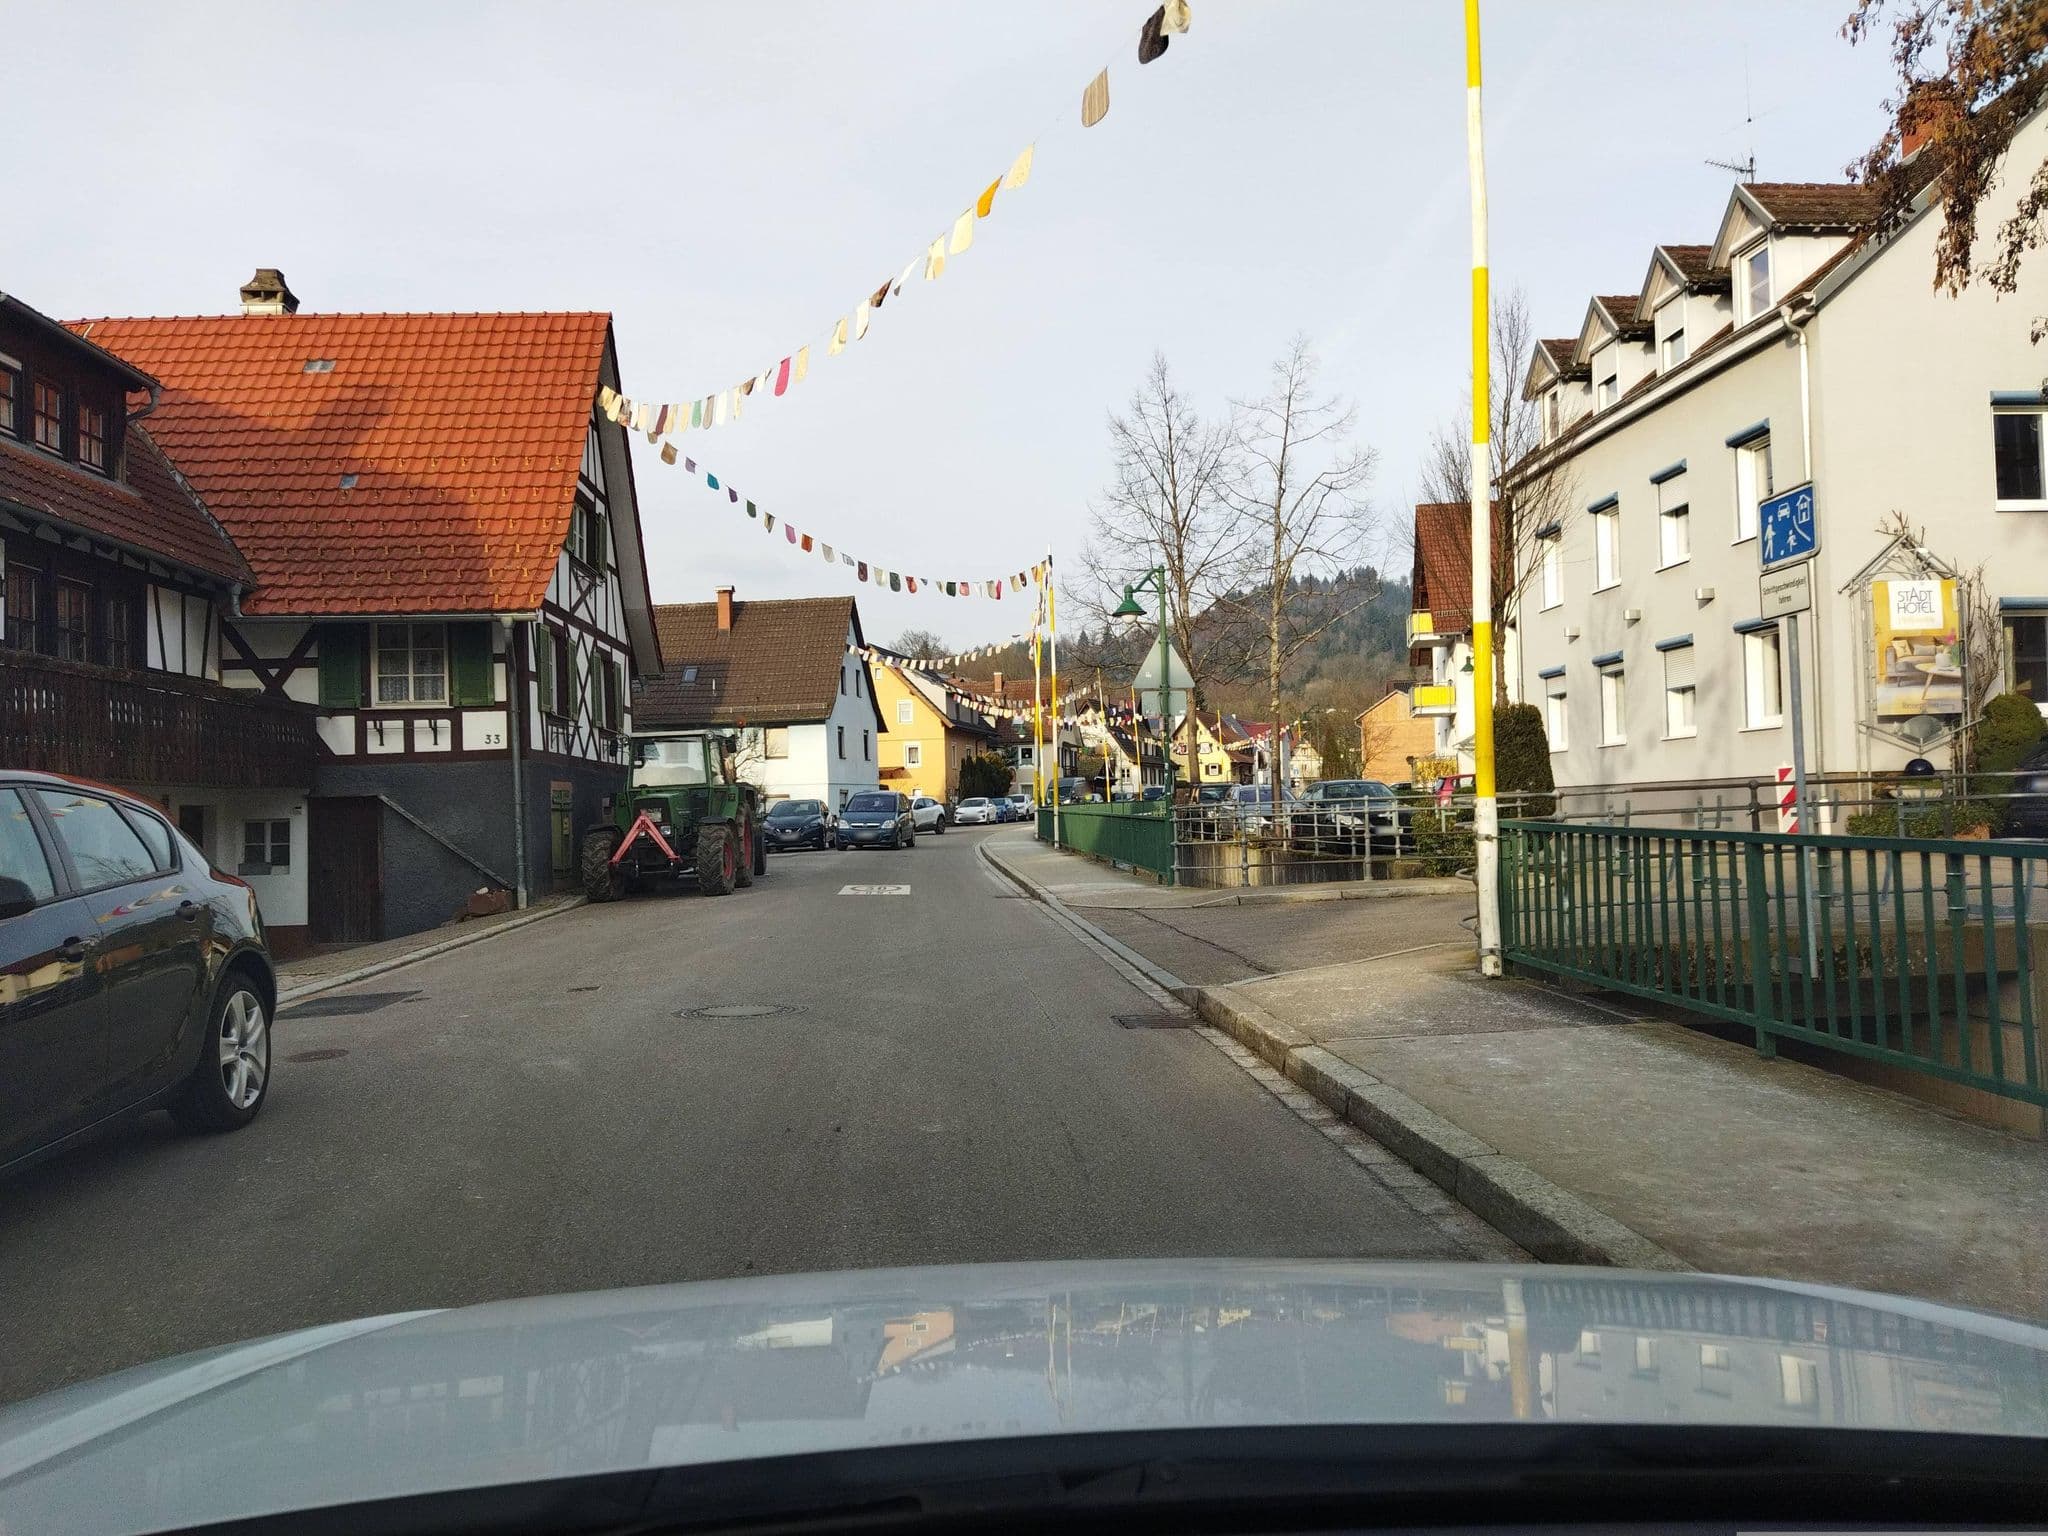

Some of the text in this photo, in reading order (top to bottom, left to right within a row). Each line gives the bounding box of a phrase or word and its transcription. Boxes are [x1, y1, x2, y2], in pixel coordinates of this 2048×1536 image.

[1897, 587, 1934, 602] STADT
[1896, 601, 1936, 614] HOTEL
[484, 734, 501, 745] 33
